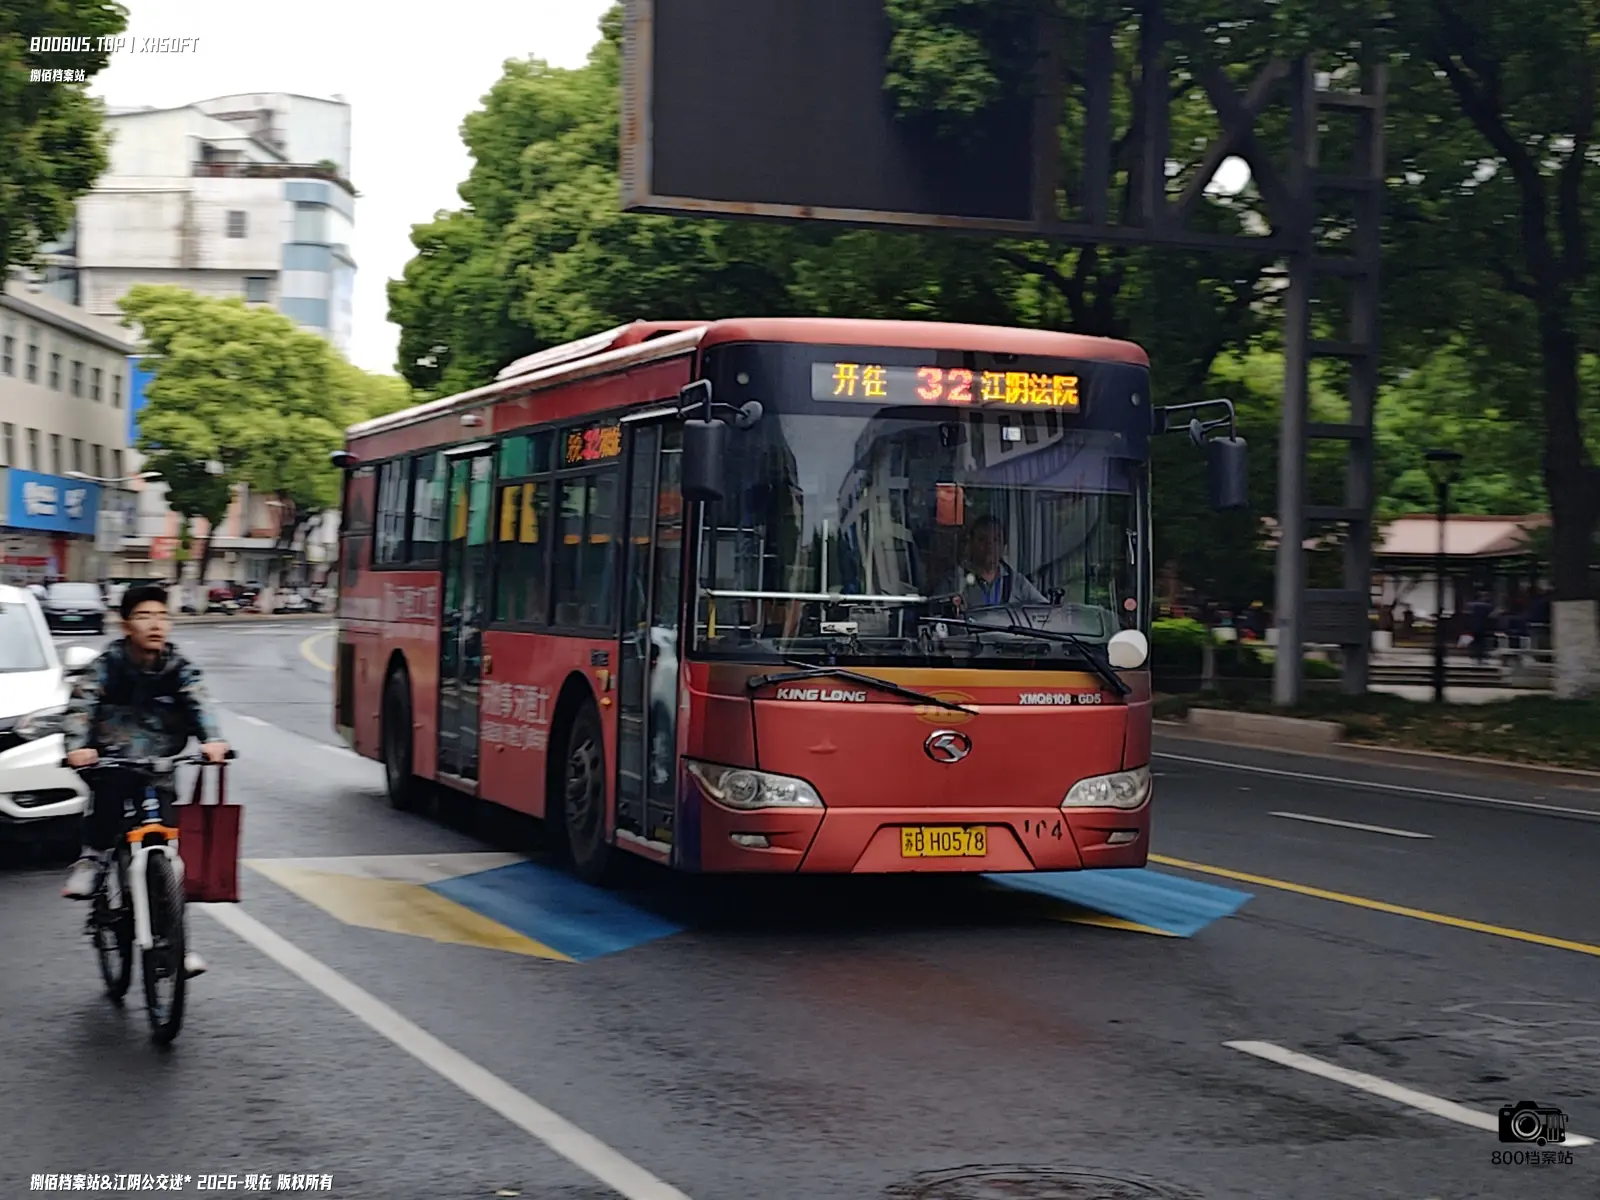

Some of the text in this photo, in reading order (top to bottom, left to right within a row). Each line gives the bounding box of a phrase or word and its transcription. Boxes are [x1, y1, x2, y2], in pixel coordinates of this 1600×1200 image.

[832, 363, 1079, 405] 开往 32 江阴法院
[776, 688, 866, 702] KING LONG
